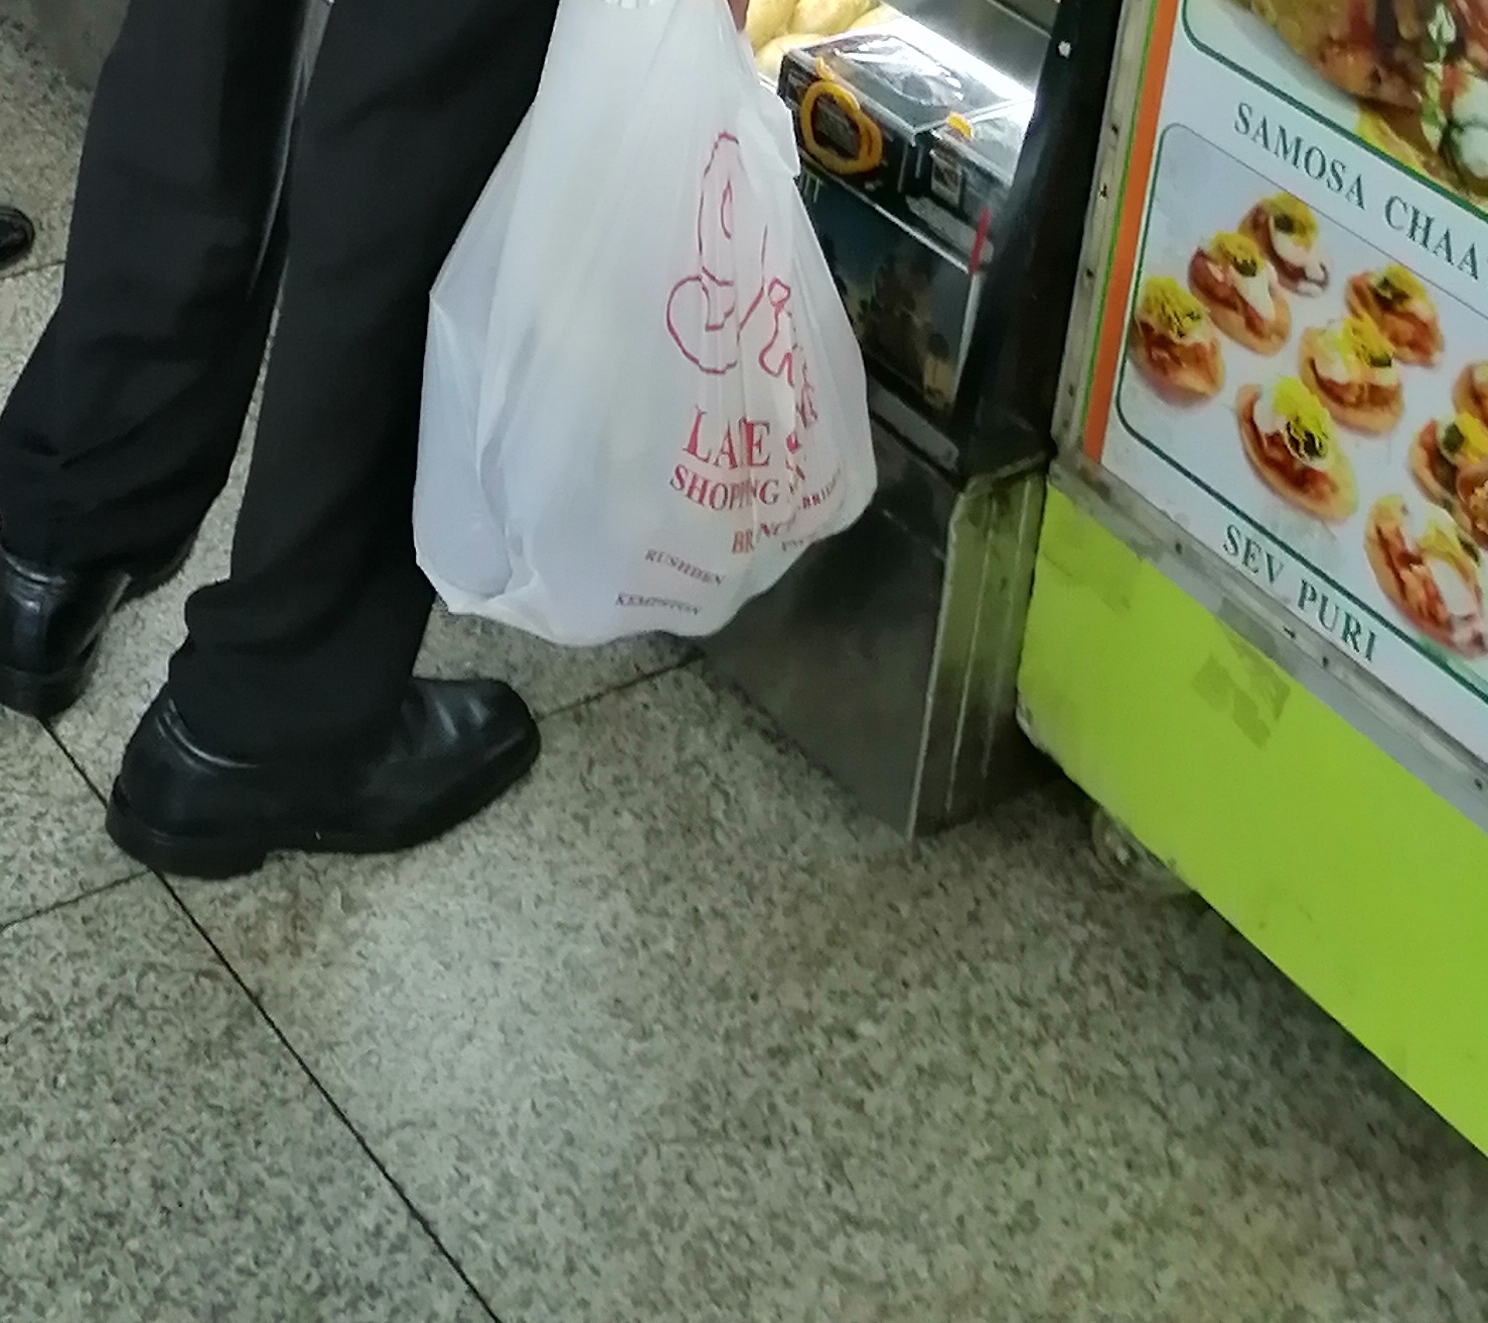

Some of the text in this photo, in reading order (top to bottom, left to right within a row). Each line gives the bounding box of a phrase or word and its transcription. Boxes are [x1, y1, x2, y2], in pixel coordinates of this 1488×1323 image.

[1234, 103, 1488, 281] SAMOSA CHAA
[1222, 523, 1377, 663] SEV PURI
